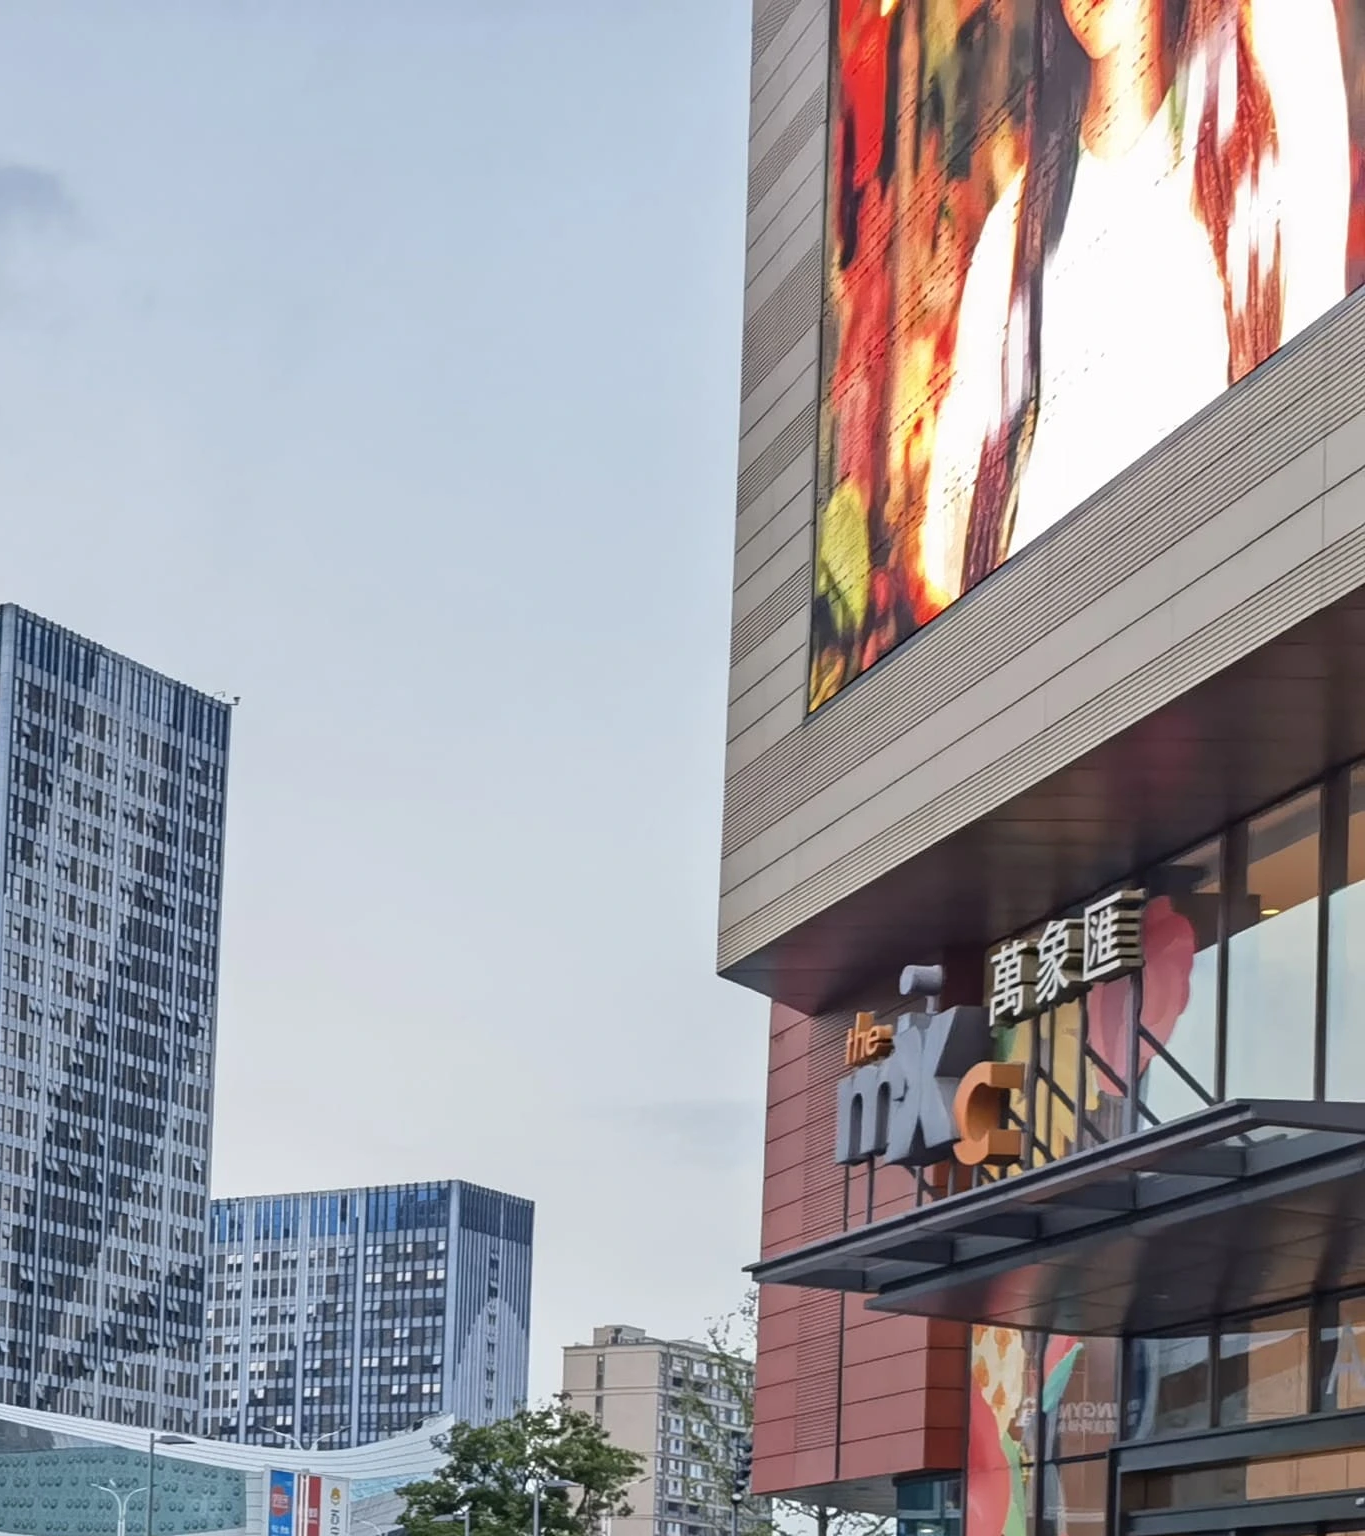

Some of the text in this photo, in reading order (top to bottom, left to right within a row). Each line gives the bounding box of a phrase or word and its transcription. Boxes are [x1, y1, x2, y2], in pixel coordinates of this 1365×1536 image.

[989, 888, 1139, 1028] 萬象匯
[846, 1011, 891, 1066] the
